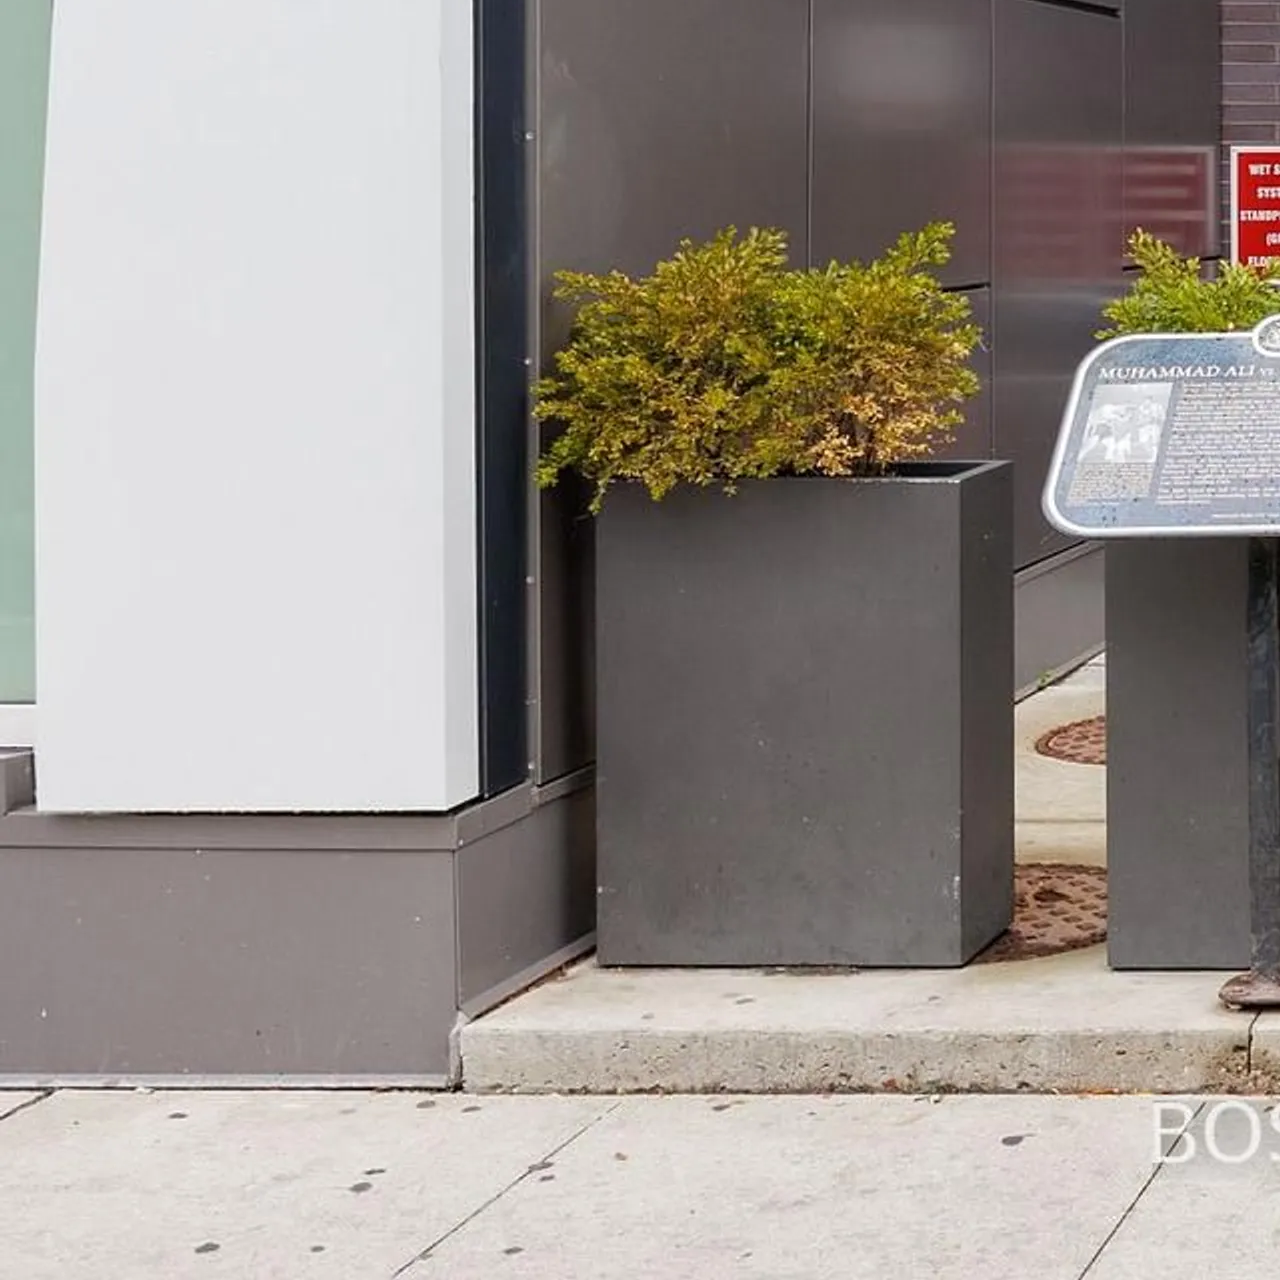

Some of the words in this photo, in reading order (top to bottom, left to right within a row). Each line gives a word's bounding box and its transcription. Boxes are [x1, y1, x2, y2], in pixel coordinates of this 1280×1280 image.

[1249, 163, 1270, 175] WET
[1099, 365, 1220, 380] MUHAMMAD
[1224, 365, 1256, 377] ALI
